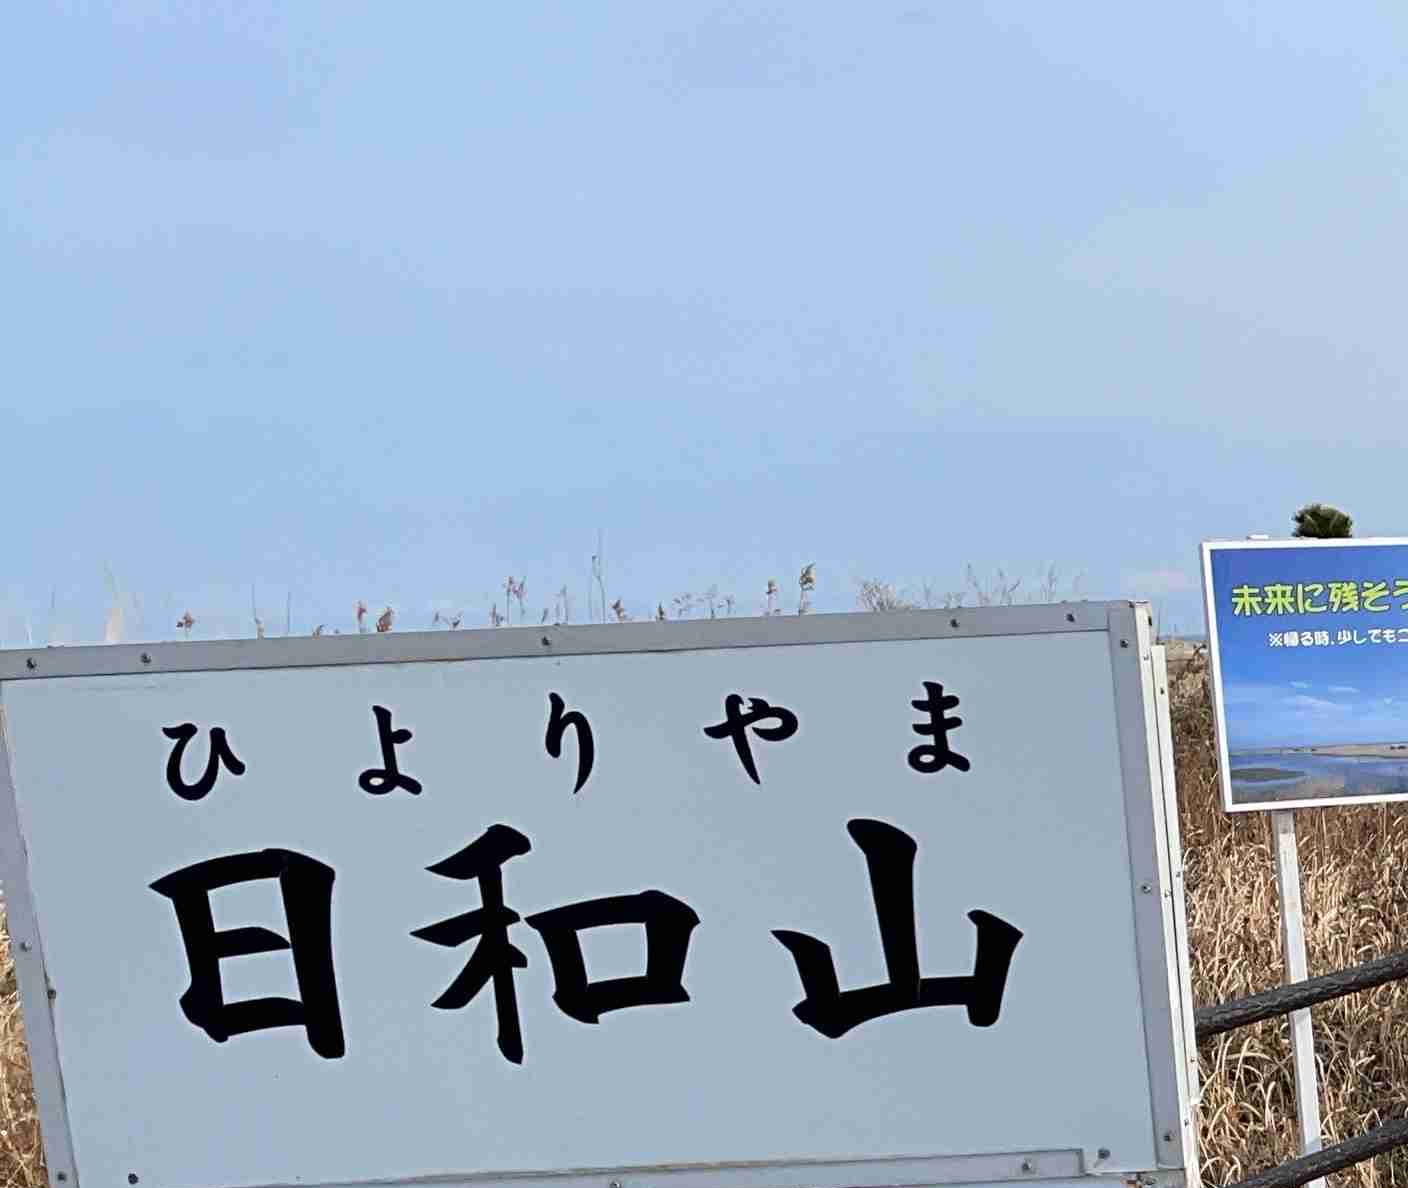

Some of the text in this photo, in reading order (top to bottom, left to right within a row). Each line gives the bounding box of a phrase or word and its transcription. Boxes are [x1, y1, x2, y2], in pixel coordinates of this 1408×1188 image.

[161, 679, 972, 800] ひよりやま
[149, 817, 1023, 1064] 日和山
